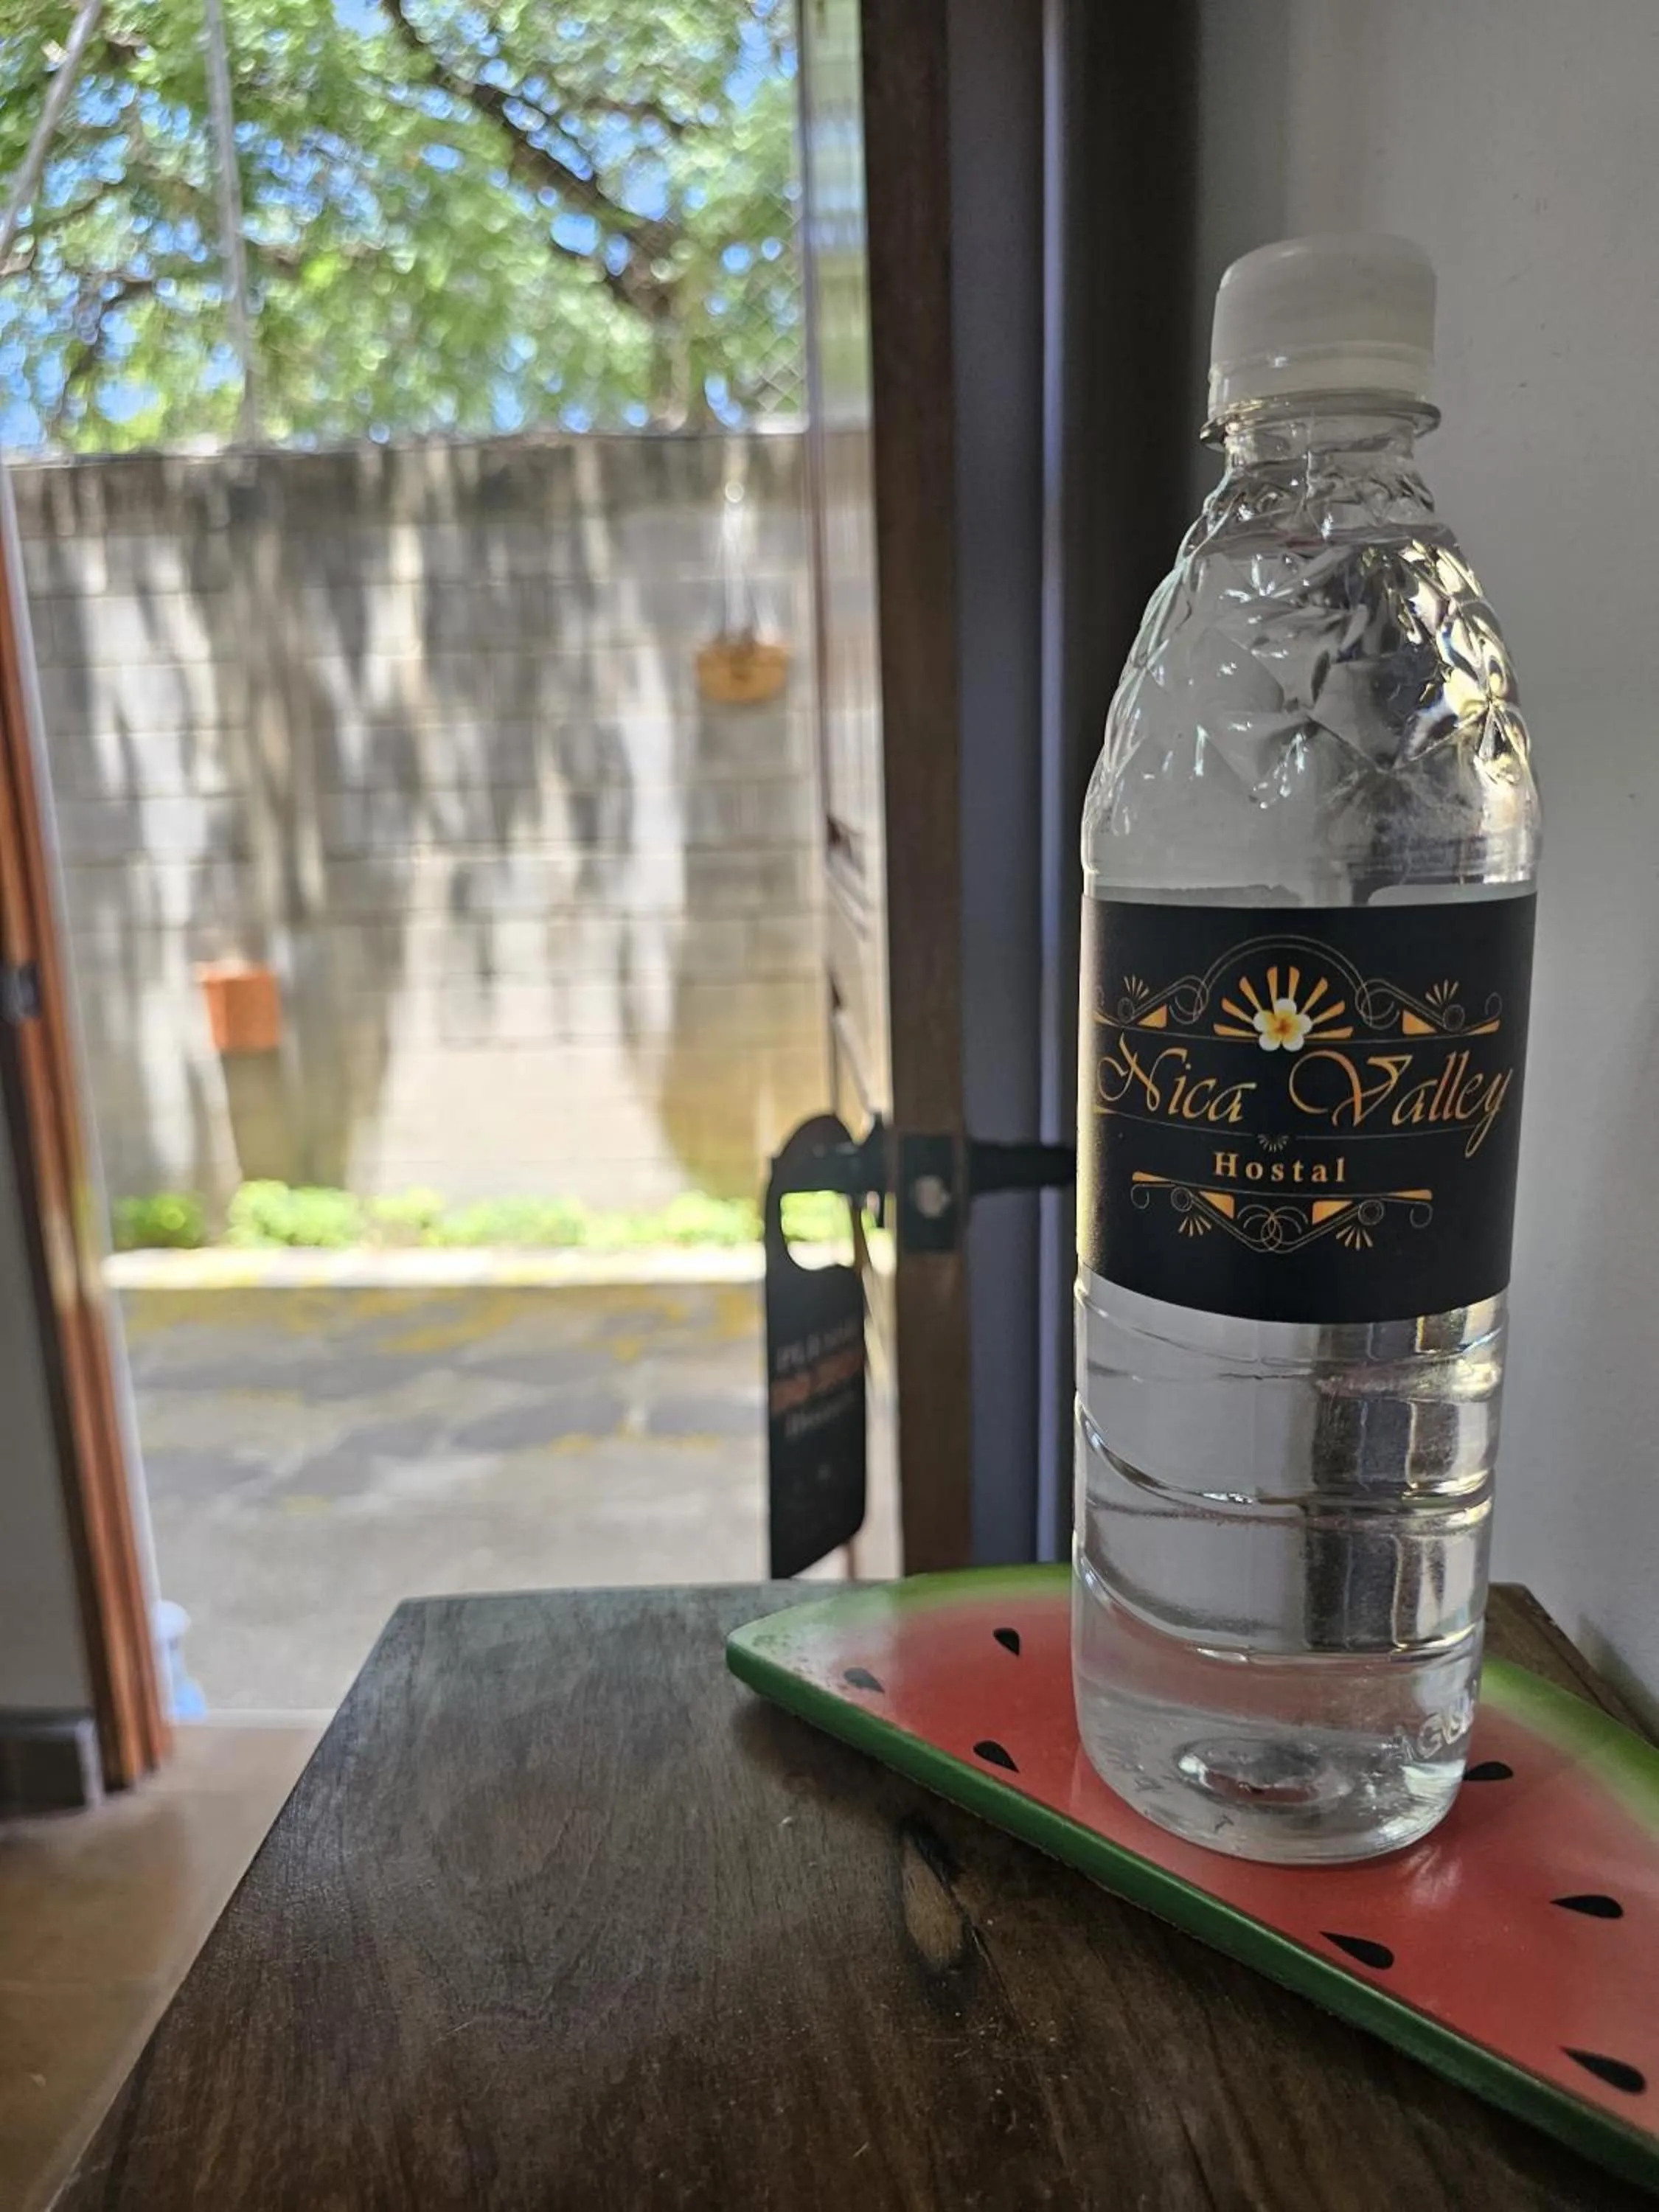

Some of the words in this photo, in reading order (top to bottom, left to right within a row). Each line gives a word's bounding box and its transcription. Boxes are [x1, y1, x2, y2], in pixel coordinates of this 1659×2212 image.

[1097, 1032, 1257, 1123] Nica
[1289, 1050, 1512, 1158] Valley
[1214, 1150, 1345, 1183] Hostal
